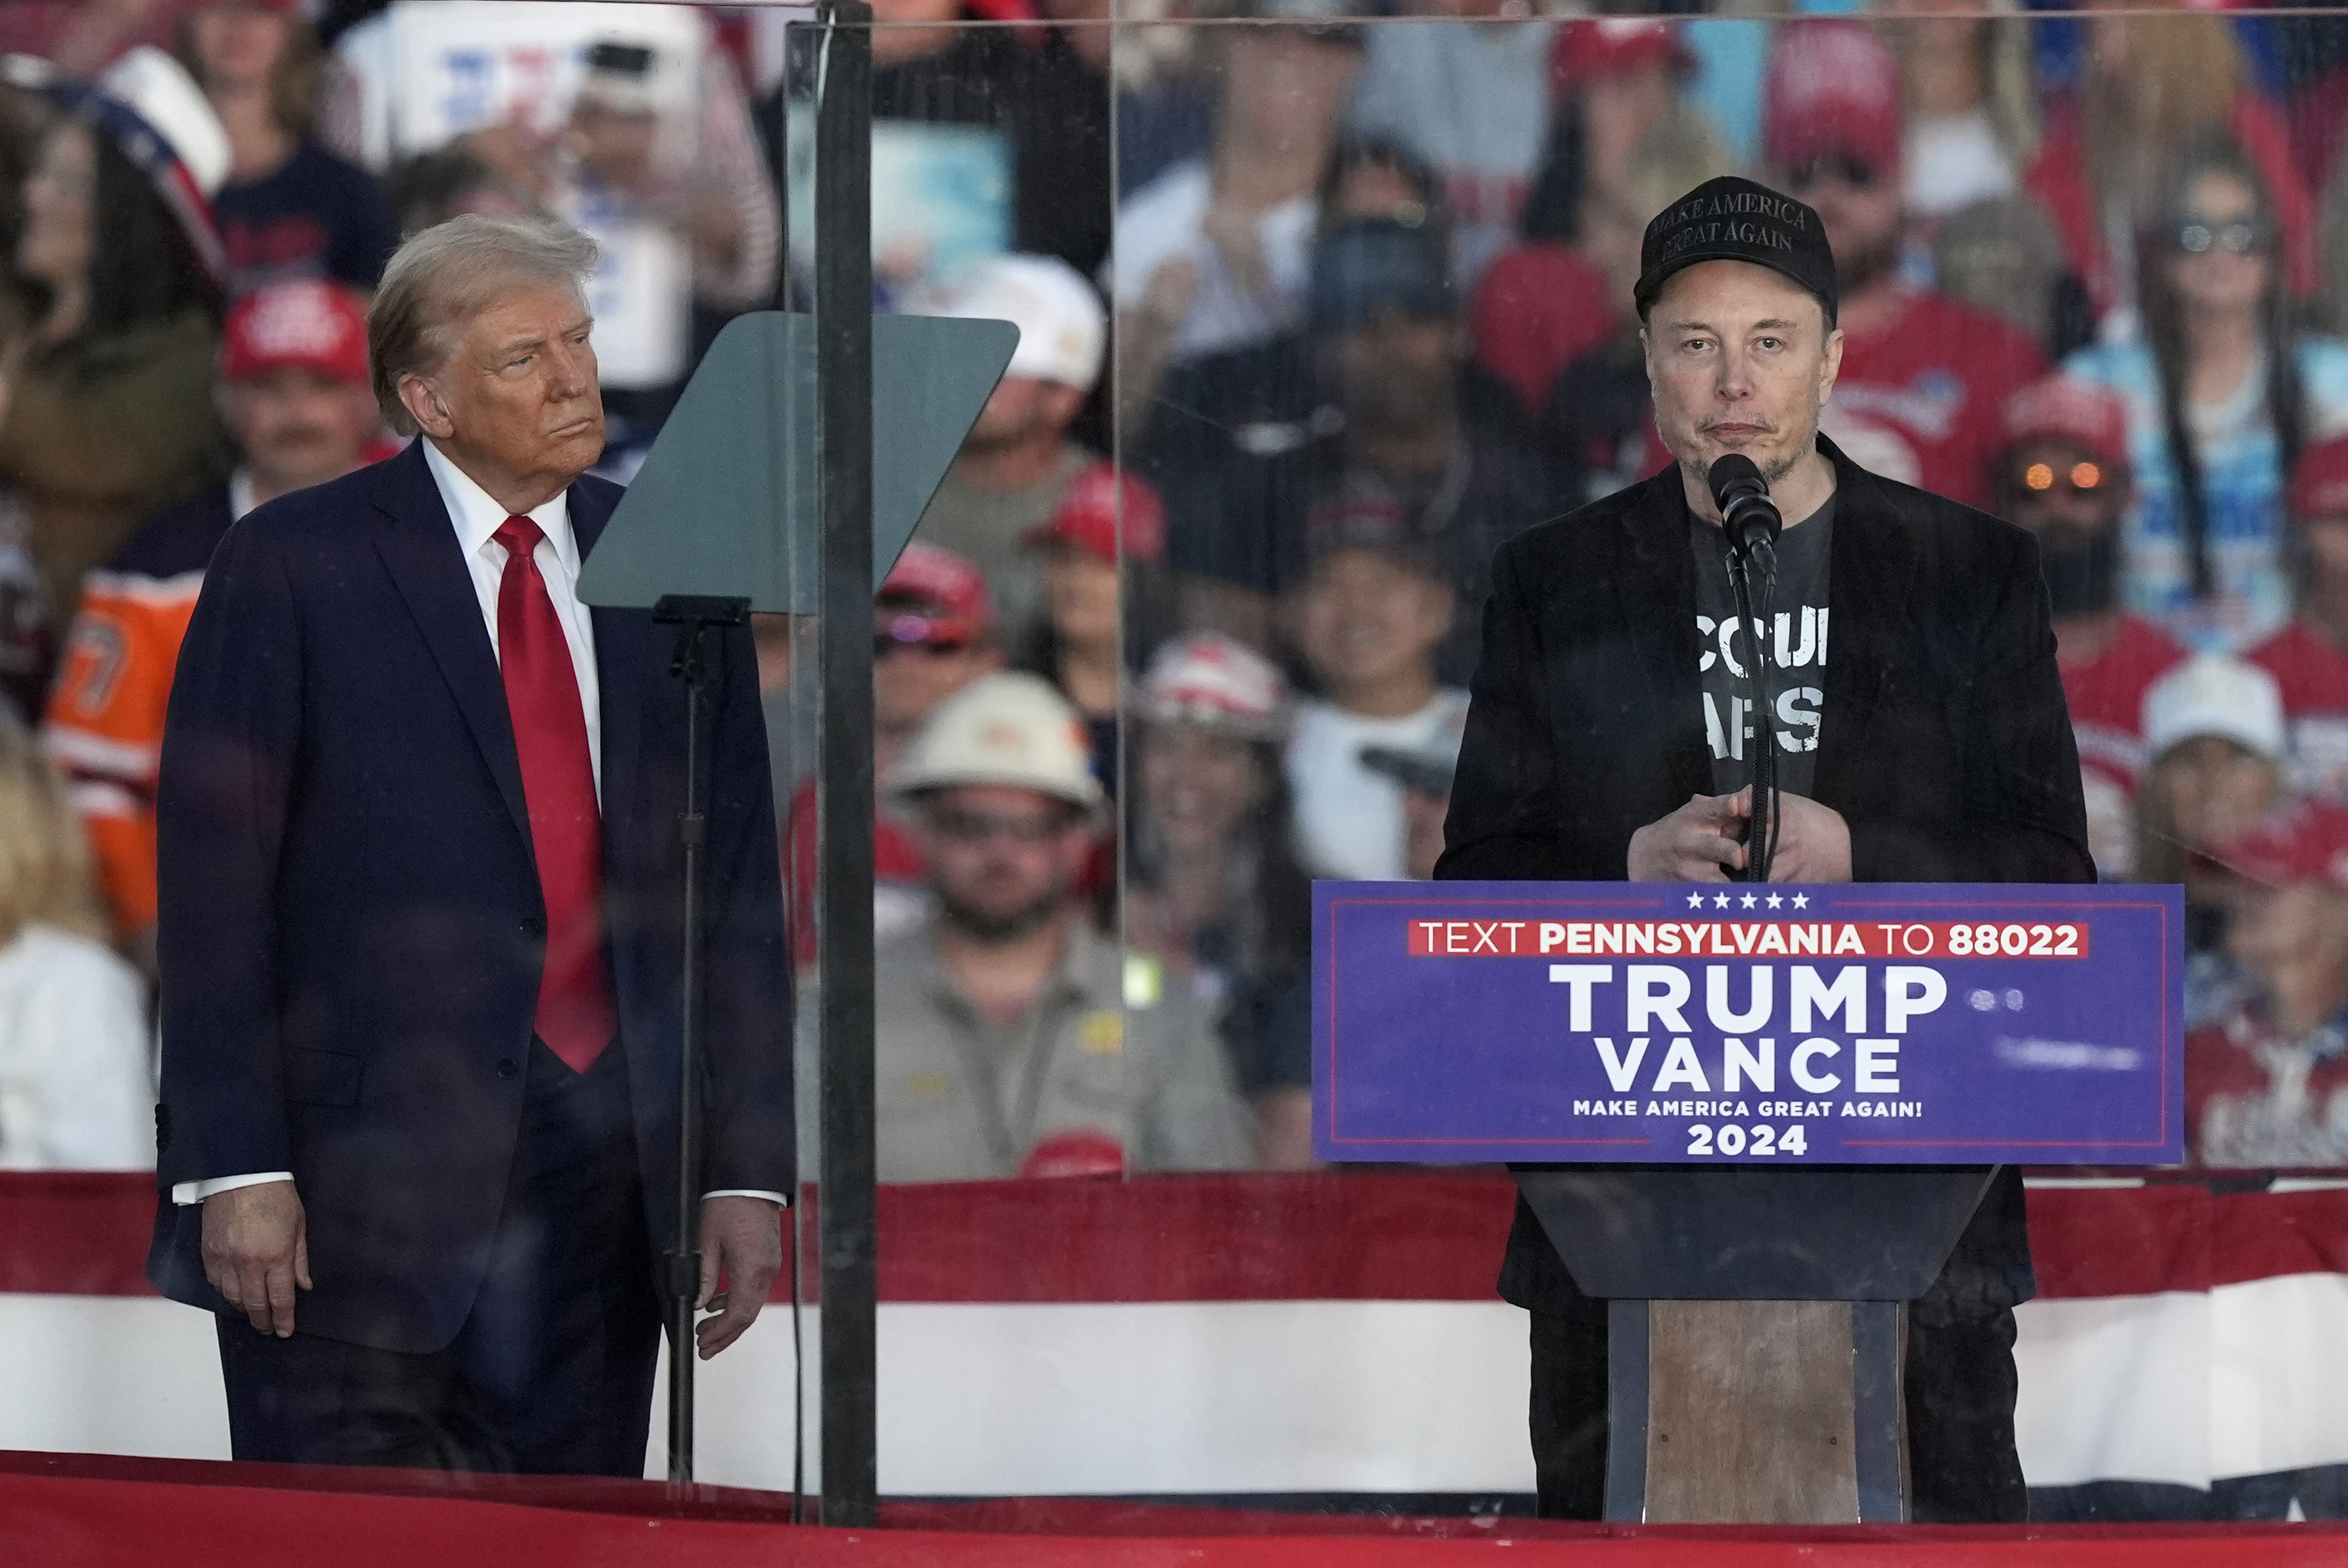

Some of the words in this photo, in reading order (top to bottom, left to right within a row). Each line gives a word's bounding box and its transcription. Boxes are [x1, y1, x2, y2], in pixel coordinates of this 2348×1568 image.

[1649, 197, 1703, 239] MAKE
[1707, 192, 1806, 231] AMERICA
[1661, 222, 1721, 261] GREAT
[1723, 221, 1792, 253] AGAIN
[1419, 922, 1526, 953] TEXT
[1540, 922, 1866, 955] PENNSYLVANIA
[1877, 924, 1934, 955] TO
[1948, 924, 2078, 955] 88022
[1549, 964, 1947, 1034] TRUMP
[1593, 1037, 1900, 1094] VANCE
[1574, 1100, 1637, 1116] MAKE
[1645, 1100, 1750, 1117] AMERICA
[1758, 1101, 1833, 1117] GREAT
[1840, 1101, 1922, 1118] AGAIN!
[1687, 1124, 1808, 1156] 2024
